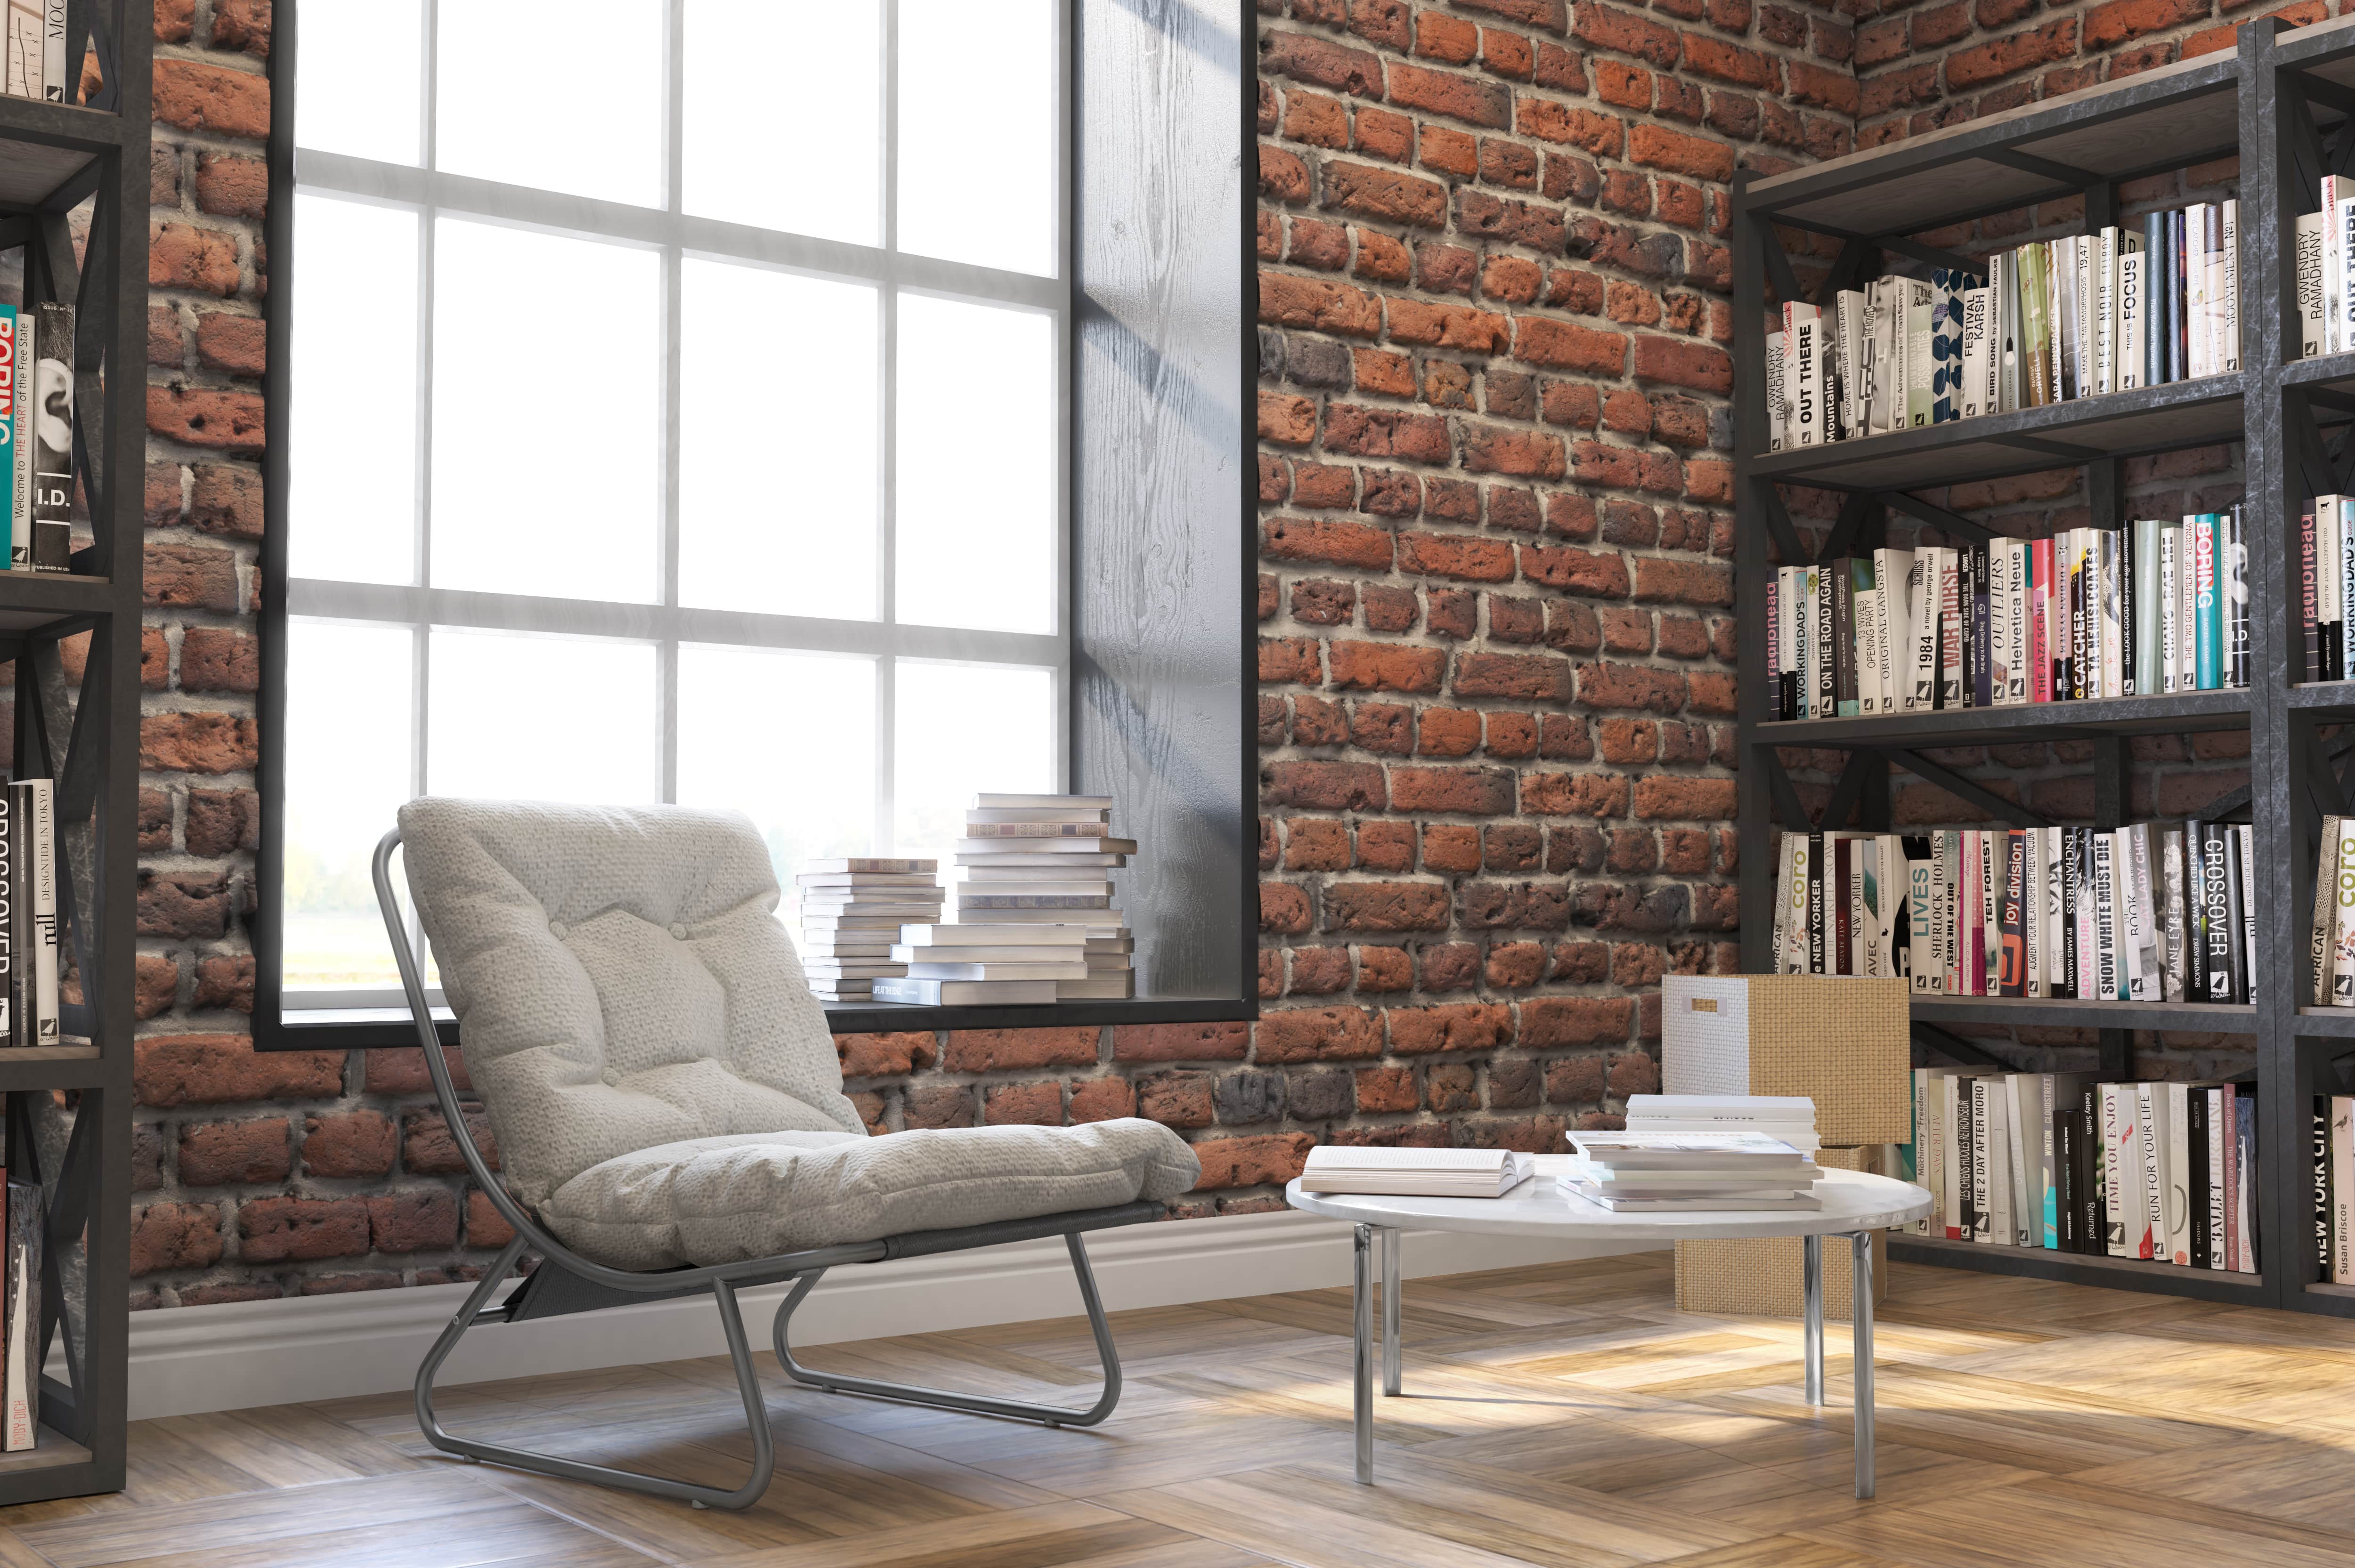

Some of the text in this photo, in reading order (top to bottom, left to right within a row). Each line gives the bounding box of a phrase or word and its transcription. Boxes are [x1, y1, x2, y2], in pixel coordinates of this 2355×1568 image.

[2124, 259, 2136, 320] FOCUS
[2298, 233, 2309, 304] GWENDRY
[2309, 230, 2322, 319] RAMADHANY
[19, 323, 28, 347] State
[1965, 295, 1975, 356] FESTIVAL
[1974, 294, 1985, 339] KARSH
[18, 350, 27, 370] Free
[18, 373, 26, 388] the
[1776, 346, 1784, 420] RAMADHANY
[1800, 324, 1811, 423] OUT THERE
[17, 391, 26, 401] of
[17, 404, 26, 436] HEART
[1825, 376, 1835, 442] Mountains
[16, 439, 25, 457] THE
[17, 461, 24, 469] to
[38, 489, 70, 507] I.D.
[1913, 560, 1924, 586] SCHUSS
[2196, 522, 2213, 609] BORING
[1820, 568, 1832, 689] ON THE ROAD AGAIN
[1876, 560, 1890, 679] ORIGINAL GANGSTA
[1942, 564, 1959, 669] WAR HORSE
[1991, 558, 2005, 649] OUTLIERS
[2011, 551, 2022, 671] Helvetica Neue
[2037, 601, 2045, 638] SCENE
[1796, 602, 1805, 699] WORKING DAD'S
[1859, 630, 1865, 639] 13
[1865, 600, 1876, 668] OPENING PARTY
[2074, 610, 2086, 686] CATCHER
[2038, 672, 2046, 695] THE
[39, 789, 50, 900] DESIGNTIDE IN TOKYO
[1825, 841, 1834, 877] NOW
[1983, 839, 1991, 892] FOREST
[2027, 857, 2035, 883] BETWEEN
[2188, 835, 2197, 878] QUENCHED
[1793, 851, 1807, 908] coro
[1912, 868, 1929, 936] LIVES
[1932, 836, 1943, 959] SHERLOCK HOLMES
[2004, 842, 2022, 925] joy division
[2065, 835, 2075, 914] ENCHANTRESS
[2134, 834, 2151, 928] CAT LADY CHIC
[2206, 840, 2227, 956] CROSSOVER
[1812, 880, 1821, 962] NEW YORKER
[1825, 882, 1835, 933] NAKED
[1851, 873, 1861, 938] NEW YORKER
[1947, 905, 1954, 916] OF
[2028, 926, 2037, 941] YOUR
[2096, 840, 2114, 994] SNOW WHITE MUST DIE
[1868, 940, 1877, 976] AVEC
[2029, 942, 2038, 969] AUGMENT
[2080, 917, 2091, 998] ADVENTURE
[2168, 907, 2182, 976] JANE EYRE
[880, 986, 885, 994] AT
[892, 987, 901, 995] EDGE
[1975, 1086, 1984, 1116] MORO
[1933, 1115, 1941, 1173] AFTER DAYS
[1958, 1100, 1970, 1200] LES CHIENS HUOLES RETROVISEUR
[1976, 1120, 1984, 1152] AFTER
[2106, 1092, 2119, 1213] TIME YOU ENJOY
[2140, 1095, 2160, 1221] RUN FOR YOUR LIFE
[2314, 1115, 2325, 1157] CITY
[1976, 1156, 1985, 1174] DAY
[2315, 1162, 2326, 1212] YORK
[1976, 1188, 1985, 1206] THE
[2087, 1202, 2096, 1239] Returned
[2339, 1203, 2347, 1242] Briscoe
